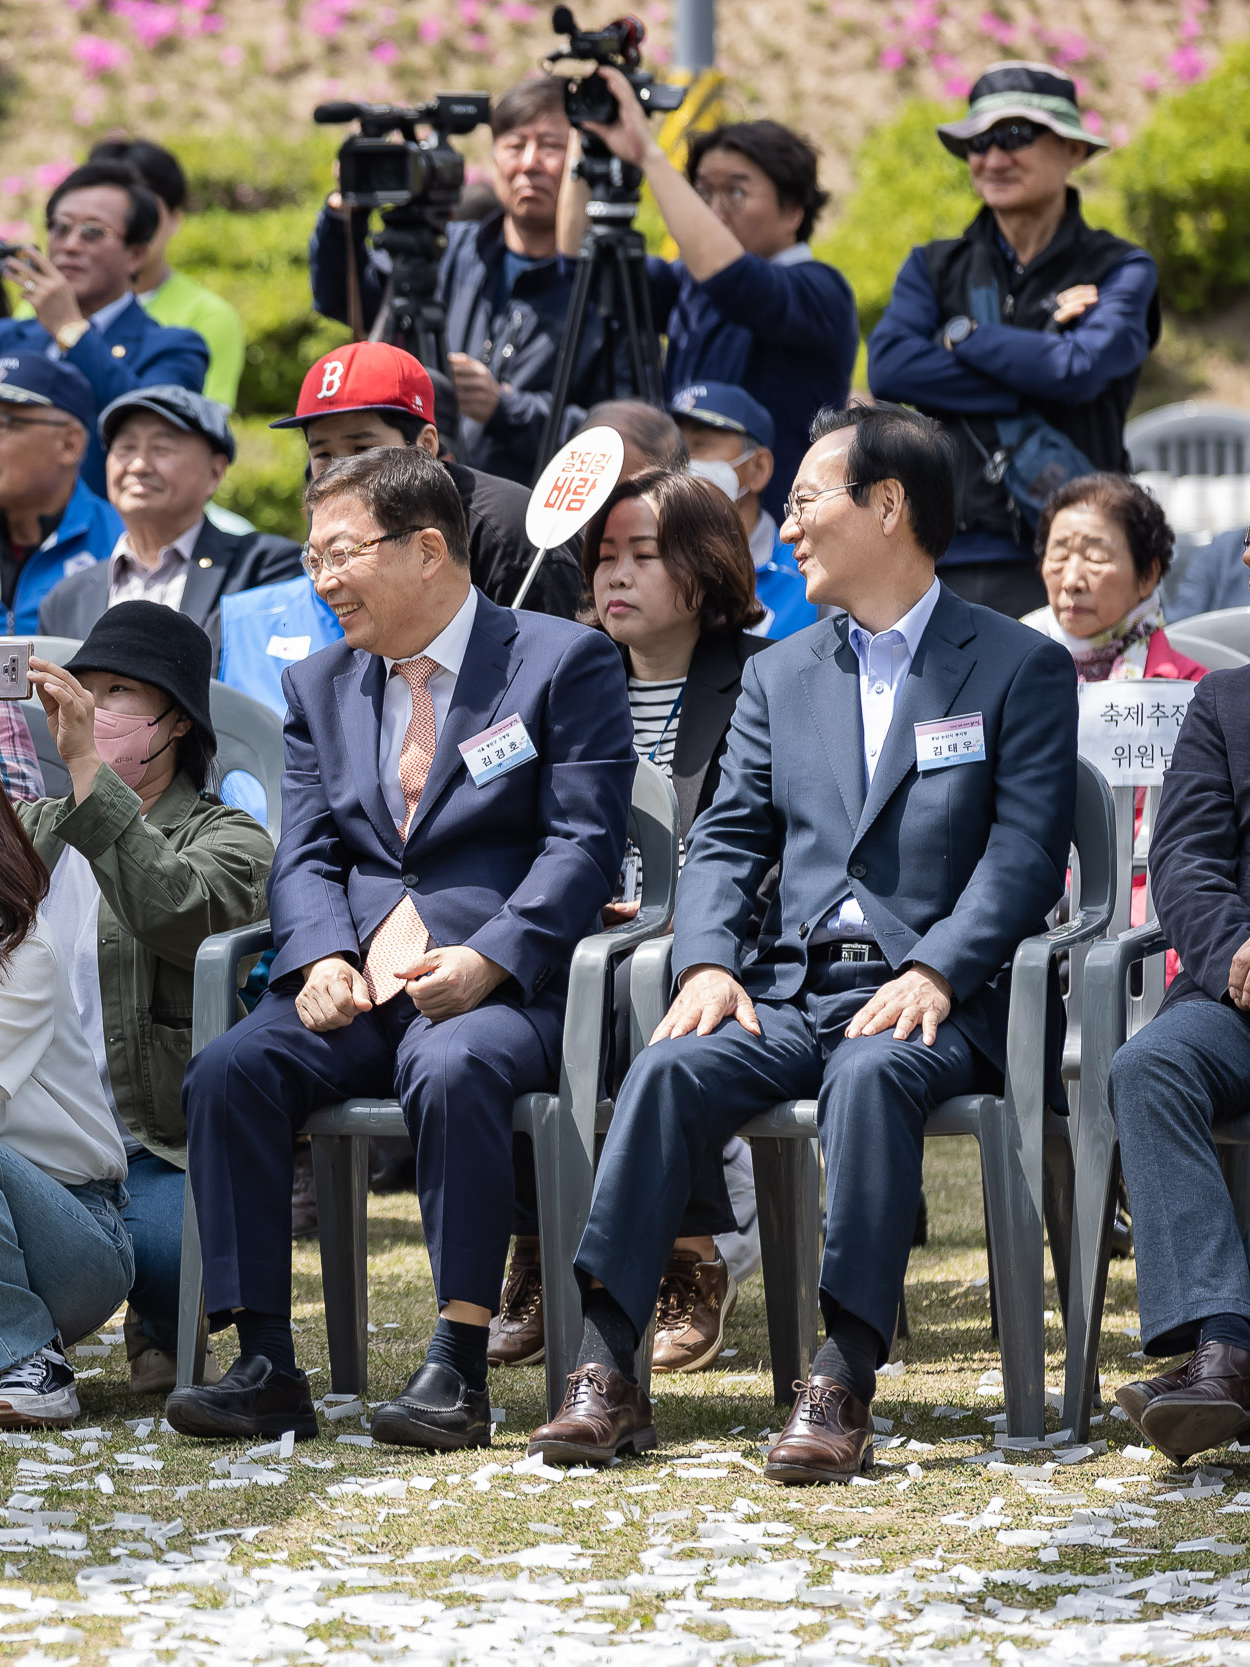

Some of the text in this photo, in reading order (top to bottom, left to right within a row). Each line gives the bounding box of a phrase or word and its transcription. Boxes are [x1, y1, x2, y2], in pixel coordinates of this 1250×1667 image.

[317, 361, 344, 399] B
[562, 451, 613, 475] 잘되길
[543, 476, 598, 512] 바람
[481, 741, 520, 767] 김경호
[933, 741, 973, 757] 김태우
